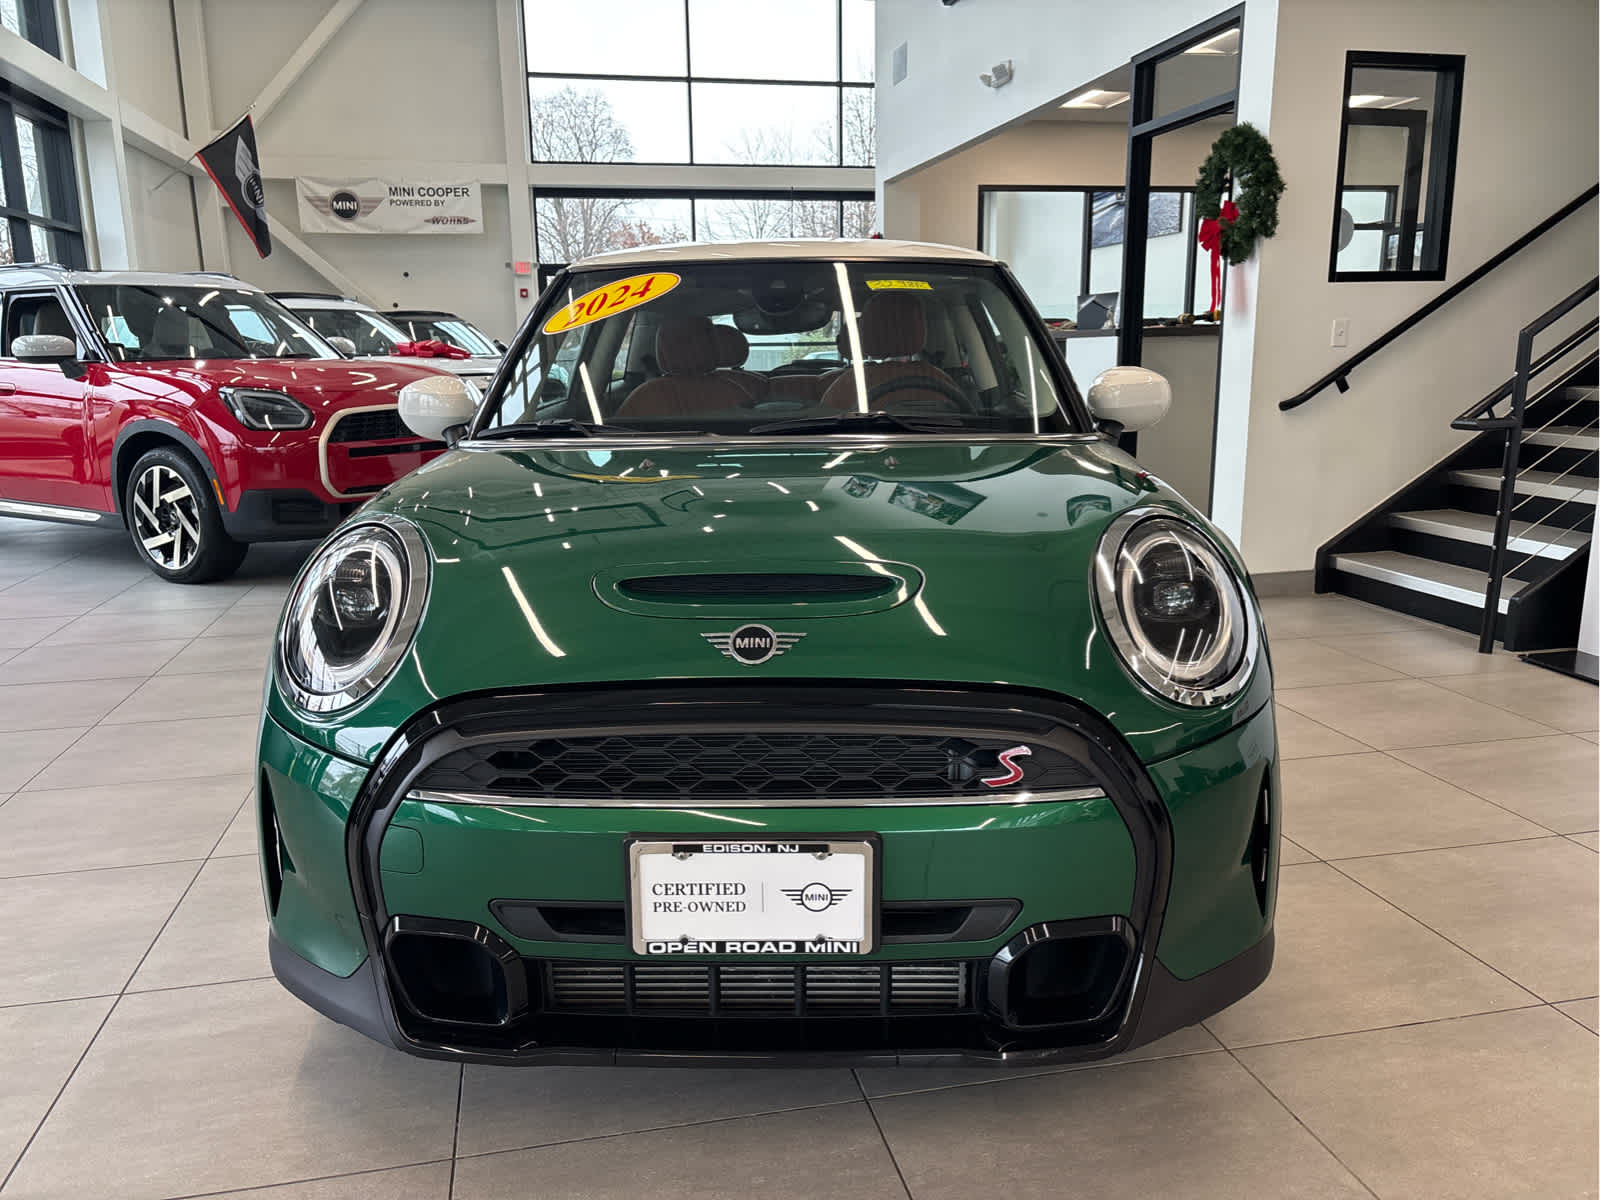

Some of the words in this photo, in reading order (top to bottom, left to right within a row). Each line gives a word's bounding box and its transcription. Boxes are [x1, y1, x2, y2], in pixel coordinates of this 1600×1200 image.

[388, 186, 414, 197] MINI
[417, 186, 470, 198] COOPER
[332, 200, 358, 210] MINI
[562, 276, 656, 328] 2024
[735, 637, 771, 648] MINI
[981, 745, 1032, 788] S
[651, 882, 747, 897] CERTIFIED
[804, 893, 829, 903] MINI
[652, 901, 746, 913] PRE-OWNED
[649, 942, 716, 954] OPEN
[725, 942, 796, 954] ROAD
[804, 942, 858, 954] MINI
